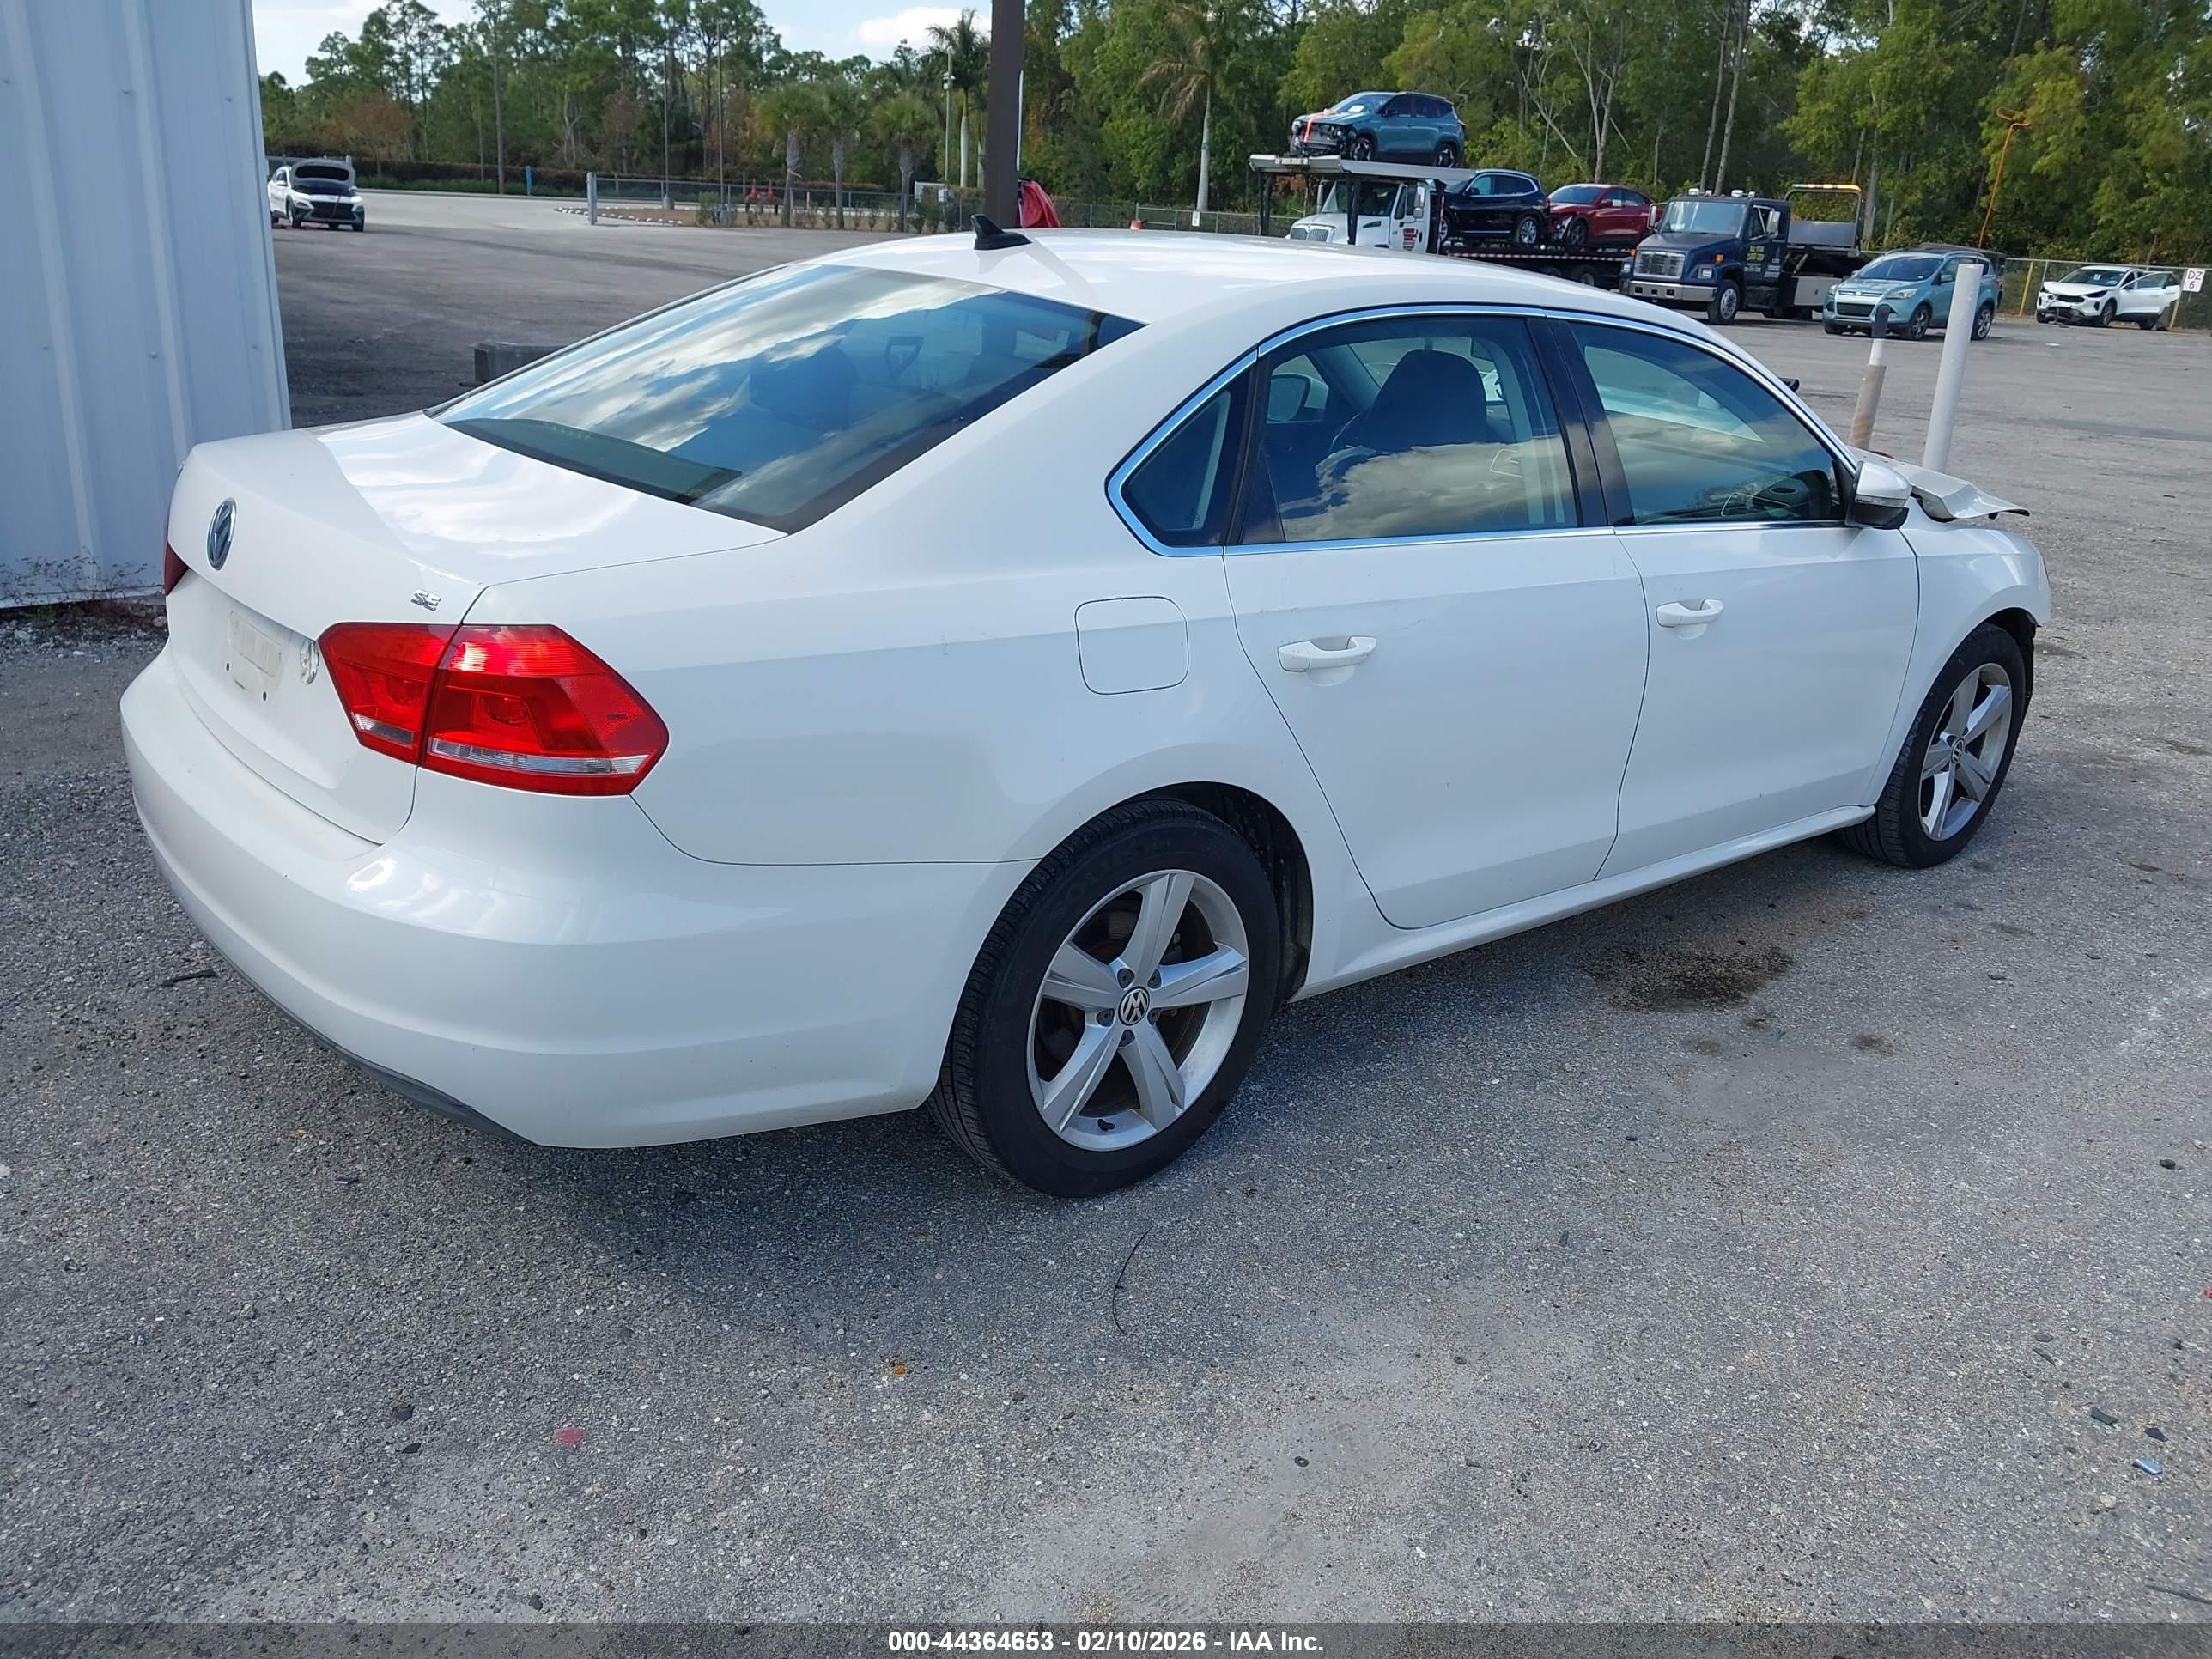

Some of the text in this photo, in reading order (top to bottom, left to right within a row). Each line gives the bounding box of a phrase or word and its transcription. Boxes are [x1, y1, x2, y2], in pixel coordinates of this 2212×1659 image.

[2187, 270, 2203, 281] DZ
[2189, 280, 2196, 289] 6
[410, 589, 441, 612] SE
